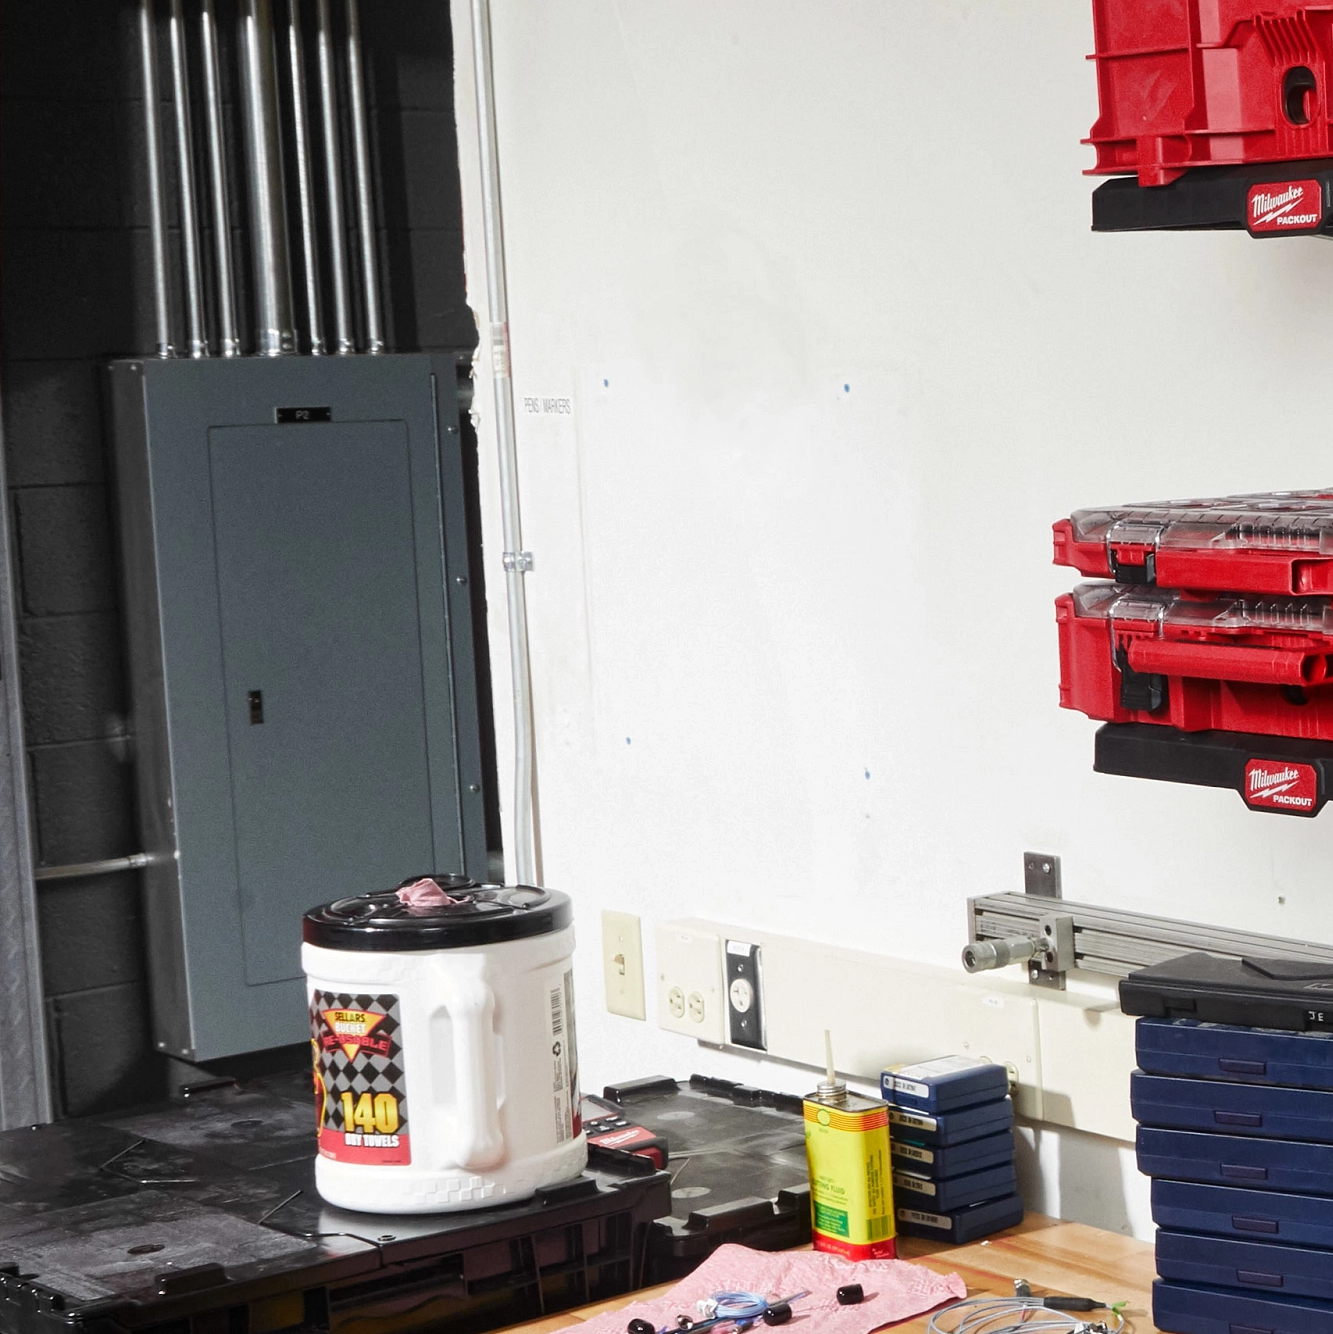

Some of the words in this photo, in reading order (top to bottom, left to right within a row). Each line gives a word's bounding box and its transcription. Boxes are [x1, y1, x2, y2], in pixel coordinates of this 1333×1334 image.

[1251, 186, 1304, 218] Milwaukee
[1277, 214, 1318, 225] PACKOUT
[1248, 767, 1300, 791] Milwaukee
[1273, 795, 1313, 807] PACKOUT
[334, 1012, 366, 1023] SELLARS
[333, 1022, 367, 1034] BUCKET
[341, 1092, 399, 1134] 140
[345, 1133, 362, 1147] DRY
[362, 1134, 400, 1148] TOWELS
